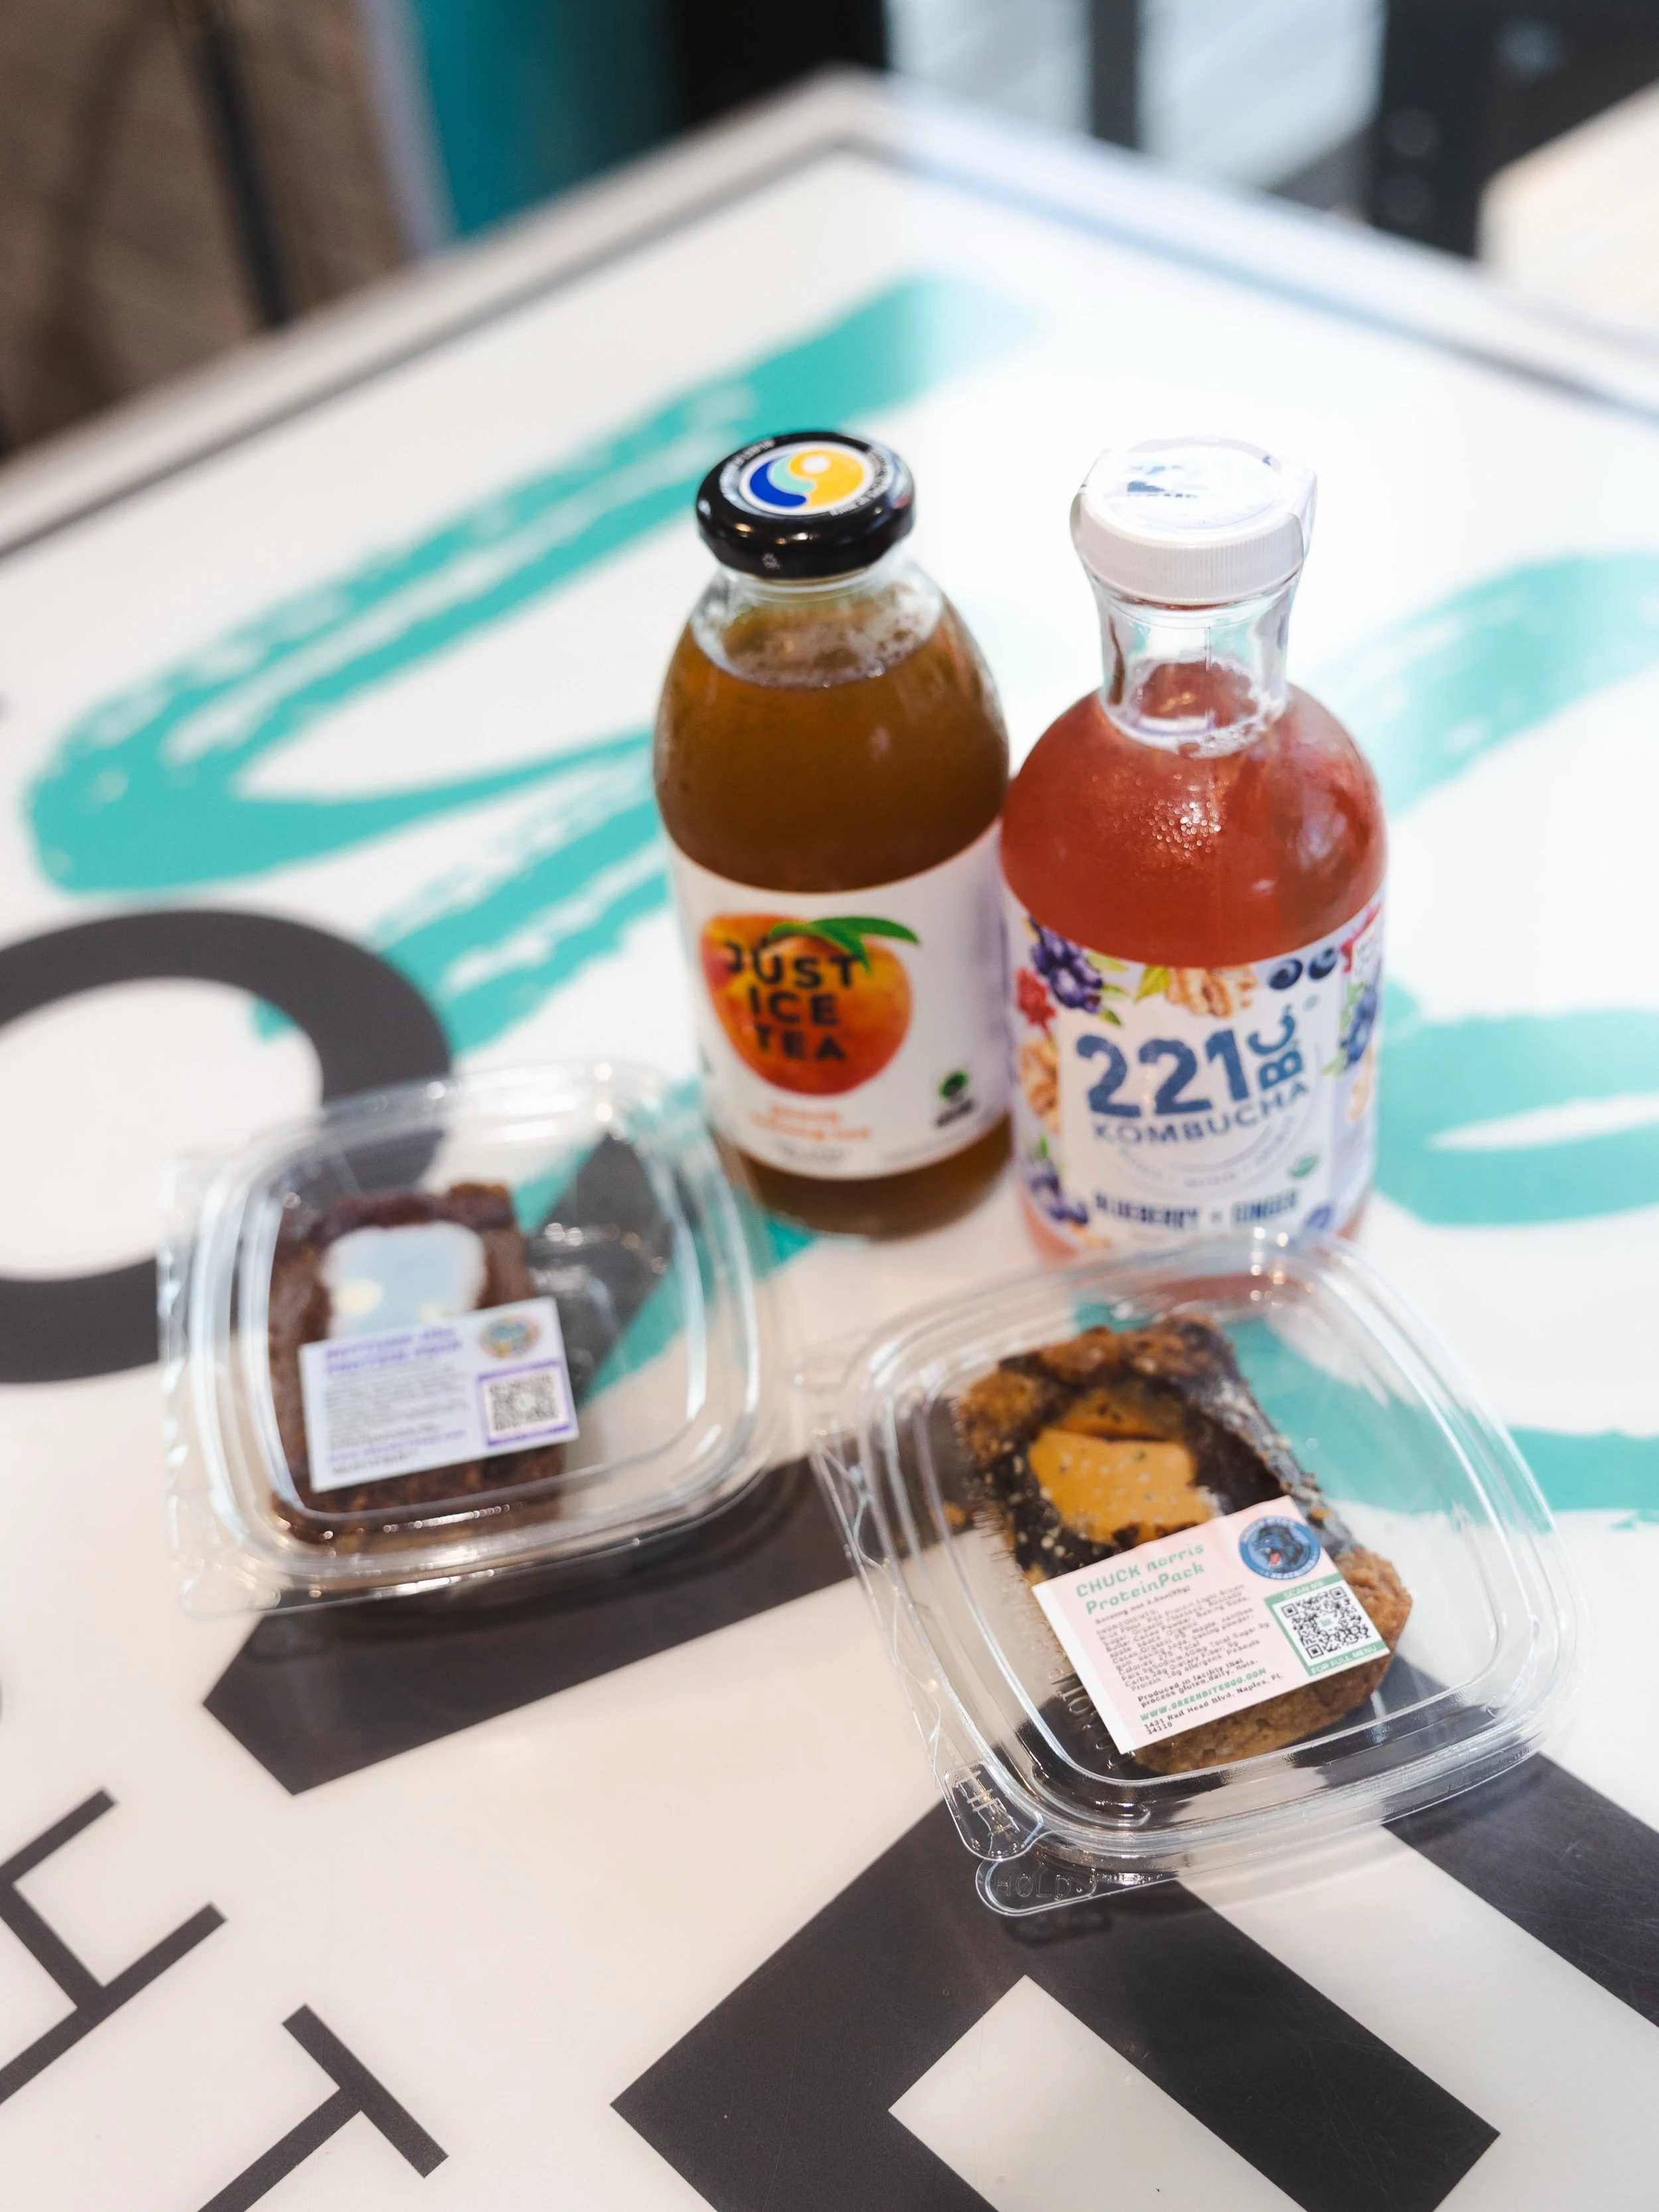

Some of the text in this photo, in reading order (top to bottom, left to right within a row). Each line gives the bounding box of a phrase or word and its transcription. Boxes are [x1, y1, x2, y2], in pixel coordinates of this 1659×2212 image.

[747, 984, 839, 1026] ICE
[754, 1022, 847, 1060] TEA
[1076, 1029, 1249, 1118] 221
[1094, 1082, 1309, 1143] KOMBUCHA
[1074, 1539, 1206, 1597] CHUCK norris
[1082, 1560, 1206, 1613] ProteinPack
[1137, 1682, 1180, 1702] Produced
[1192, 1664, 1224, 1681] facility
[1224, 1657, 1244, 1668] that
[1310, 1643, 1377, 1674] FOR FULL MENU
[1140, 1690, 1177, 1708] process
[1143, 1718, 1165, 1730] 1431
[1166, 1709, 1185, 1721] Rail
[1186, 1700, 1210, 1713] Head
[1147, 1721, 1173, 1735] 34110
